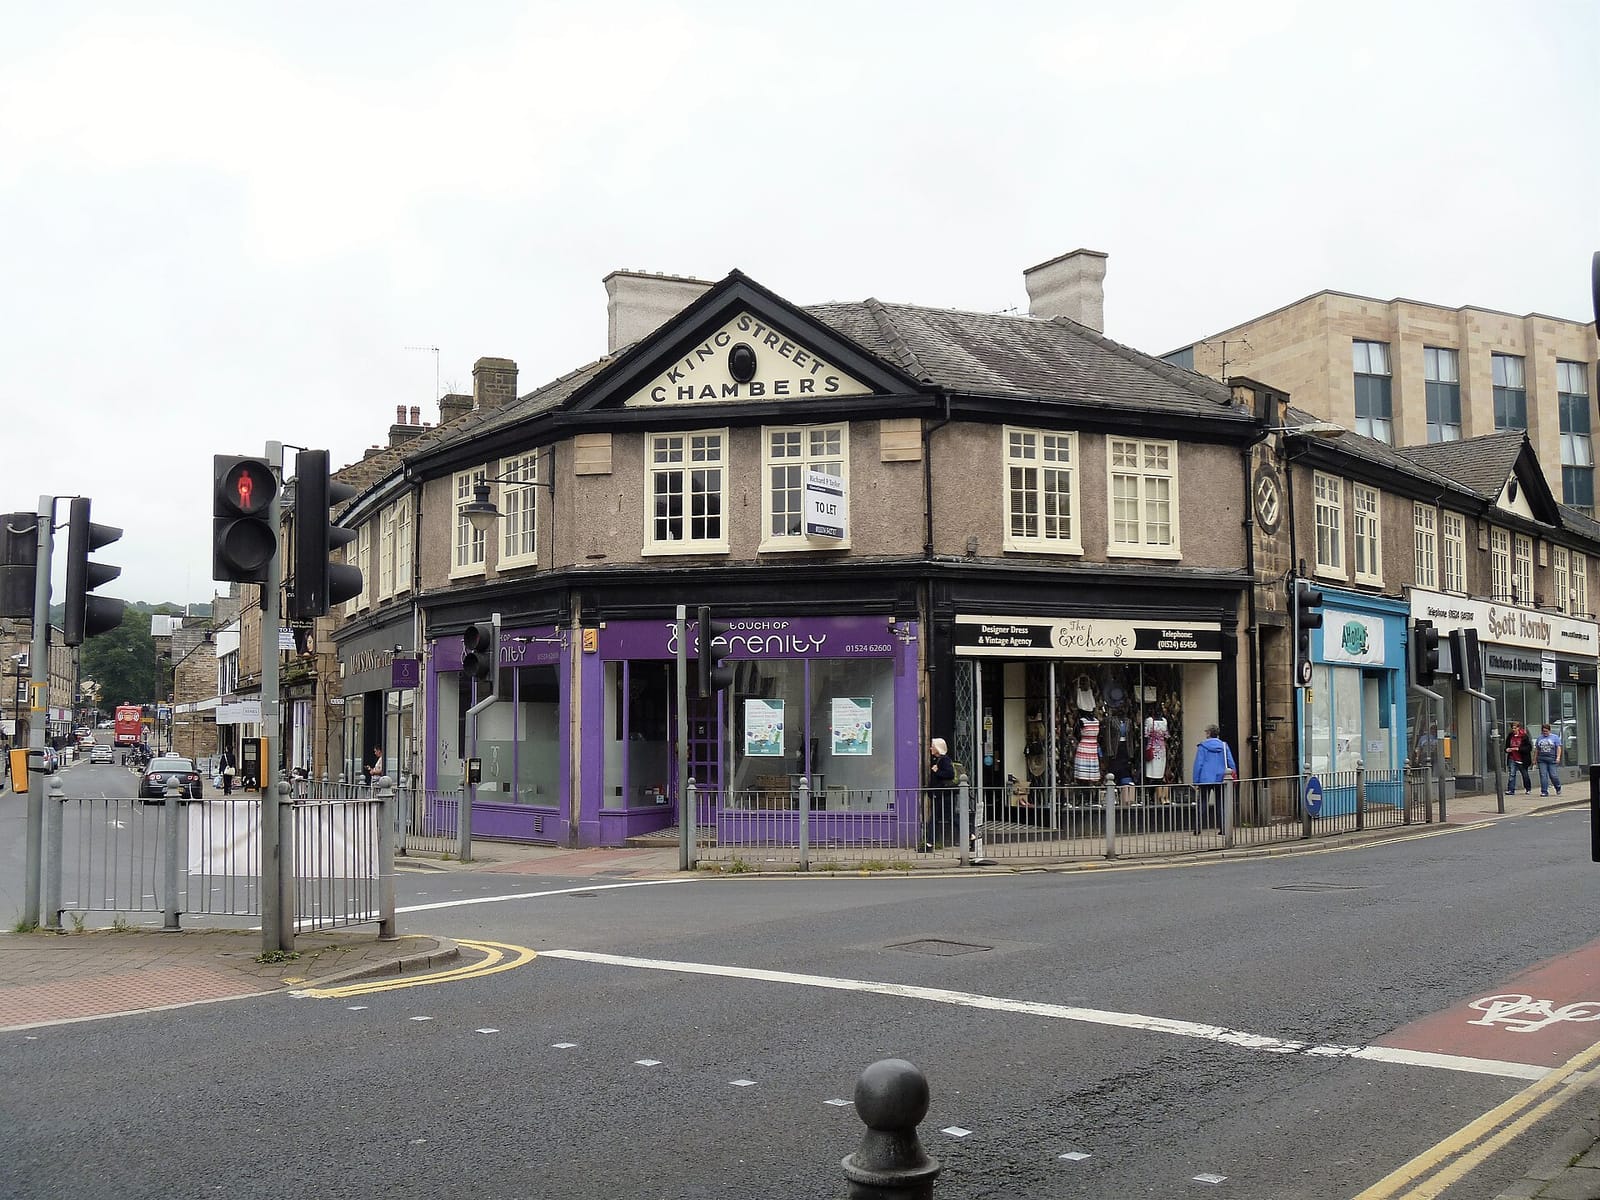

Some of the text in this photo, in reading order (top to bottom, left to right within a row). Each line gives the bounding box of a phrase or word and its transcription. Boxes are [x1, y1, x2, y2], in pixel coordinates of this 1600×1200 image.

[667, 315, 825, 384] KING STREET
[651, 375, 840, 402] CHAMBERS
[815, 501, 837, 516] TO LET
[981, 625, 1029, 635] Designer Dress
[1069, 620, 1086, 631] The
[1488, 607, 1552, 646] Scott Hornby
[978, 636, 1033, 647] & Vintage Agency
[1058, 623, 1129, 657] Exchange
[845, 644, 892, 652] 01524 62600
